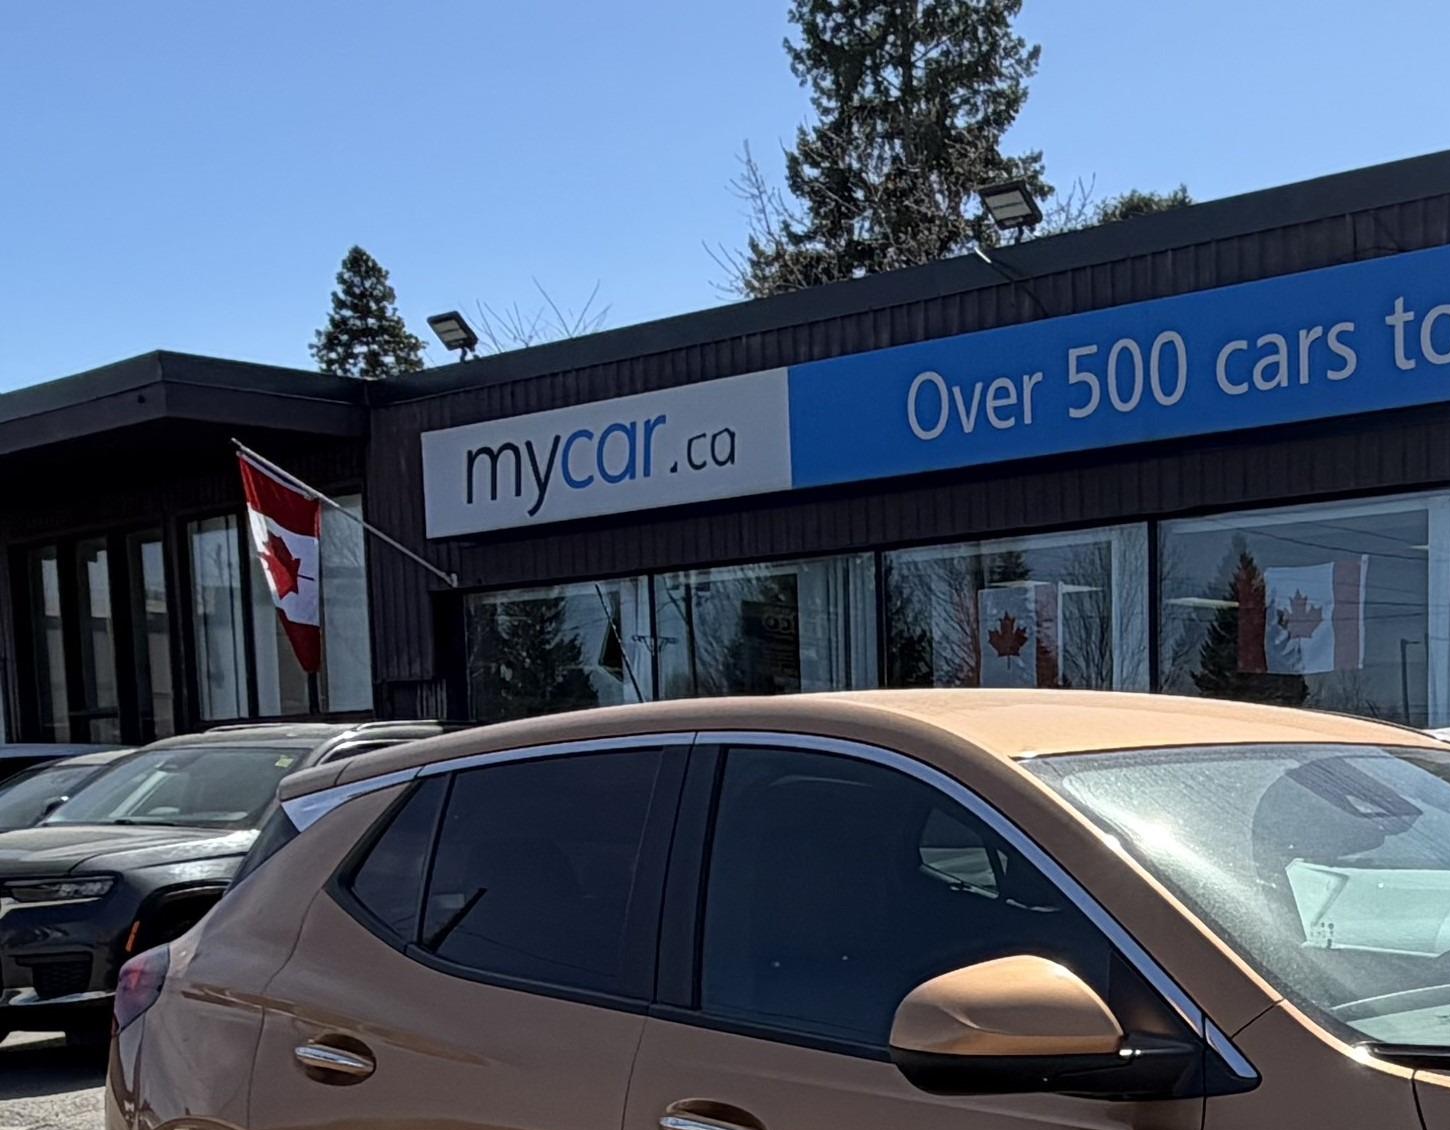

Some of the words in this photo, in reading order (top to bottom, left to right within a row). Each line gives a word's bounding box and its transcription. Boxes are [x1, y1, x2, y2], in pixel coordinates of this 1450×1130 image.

[907, 371, 1043, 440] Over
[1067, 330, 1187, 419] 500
[1215, 321, 1358, 395] cars
[466, 413, 737, 517] mycar.ca
